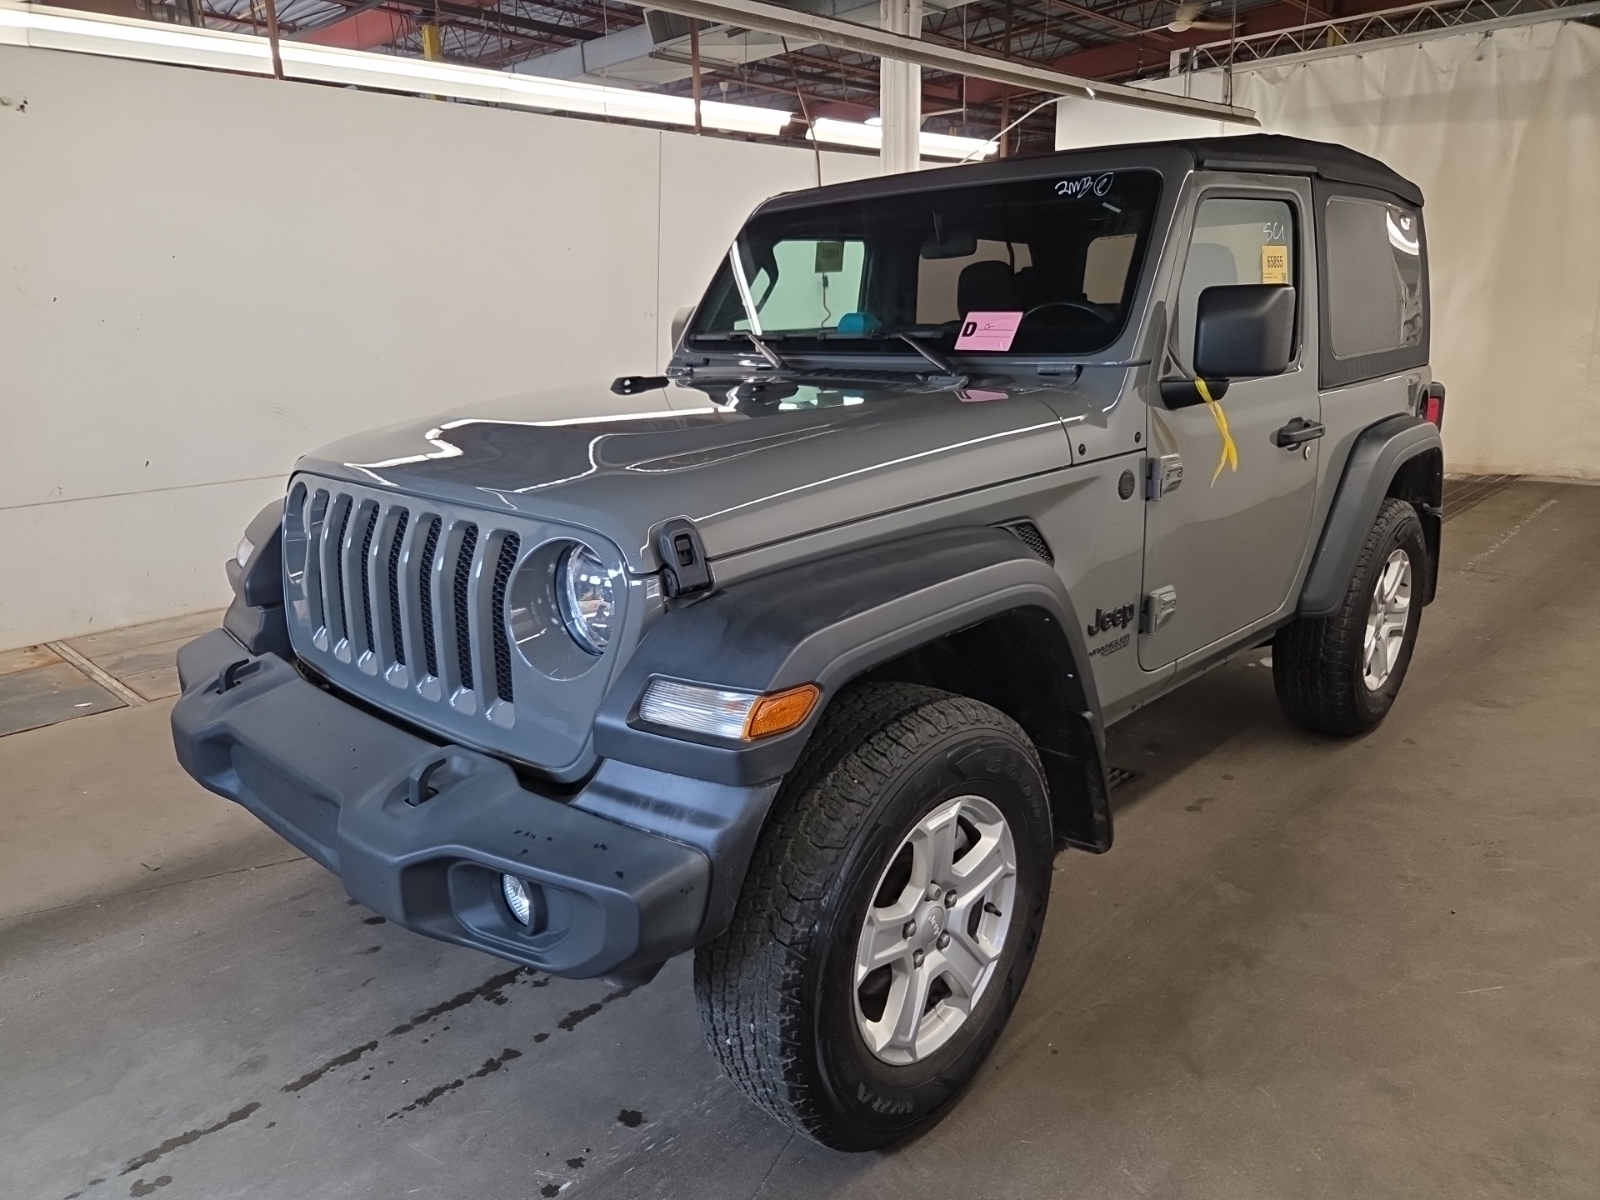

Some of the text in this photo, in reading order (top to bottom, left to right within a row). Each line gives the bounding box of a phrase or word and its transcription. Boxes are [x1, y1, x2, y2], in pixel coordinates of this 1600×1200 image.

[1266, 255, 1283, 268] 65855
[961, 321, 978, 337] D
[1087, 602, 1135, 636] Jeep
